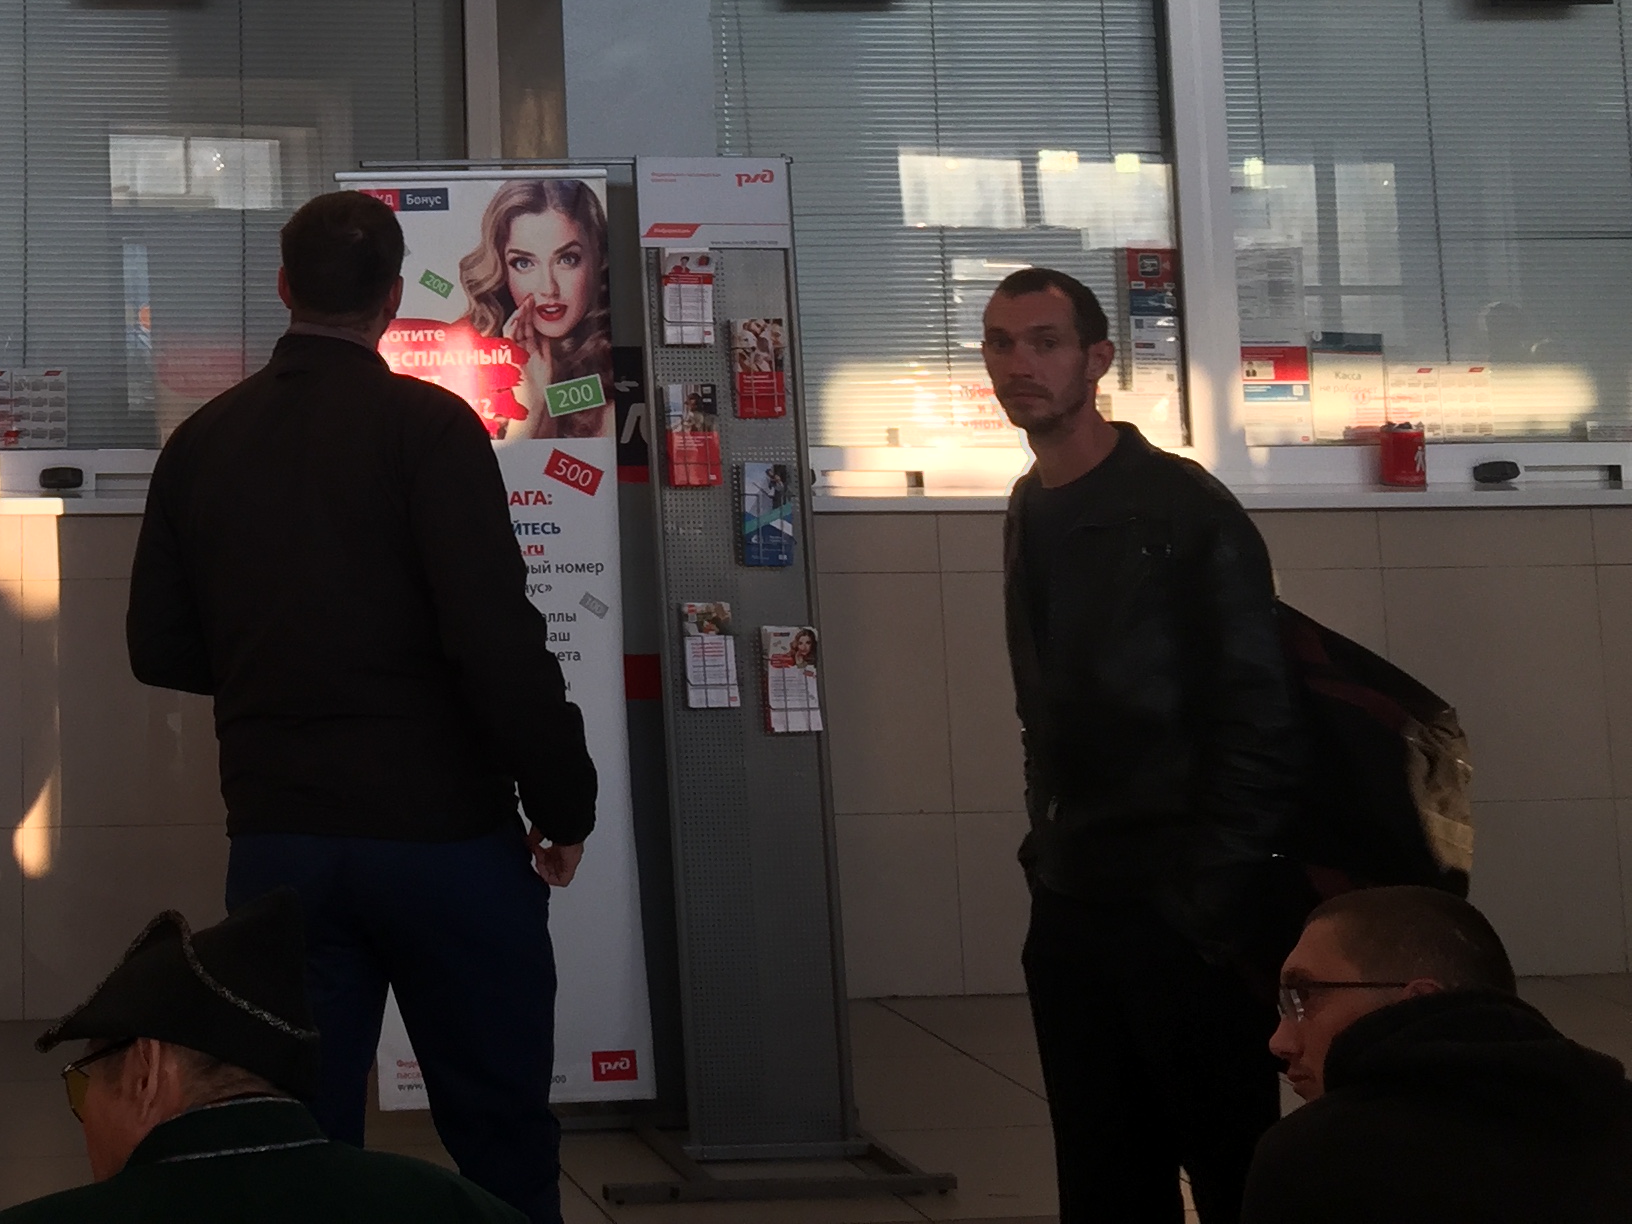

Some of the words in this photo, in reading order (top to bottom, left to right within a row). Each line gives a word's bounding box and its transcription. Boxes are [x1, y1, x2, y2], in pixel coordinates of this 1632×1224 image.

[405, 193, 442, 208] Бонус
[425, 274, 448, 294] 200
[388, 344, 512, 367] ЕСПЛАТНЫЙ
[1334, 371, 1362, 381] Касса
[556, 383, 594, 408] 200
[553, 457, 593, 487] 500
[509, 490, 554, 506] АГА:
[511, 519, 561, 536] ЙТЕСЬ
[555, 562, 604, 575] номер
[556, 651, 581, 662] ета
